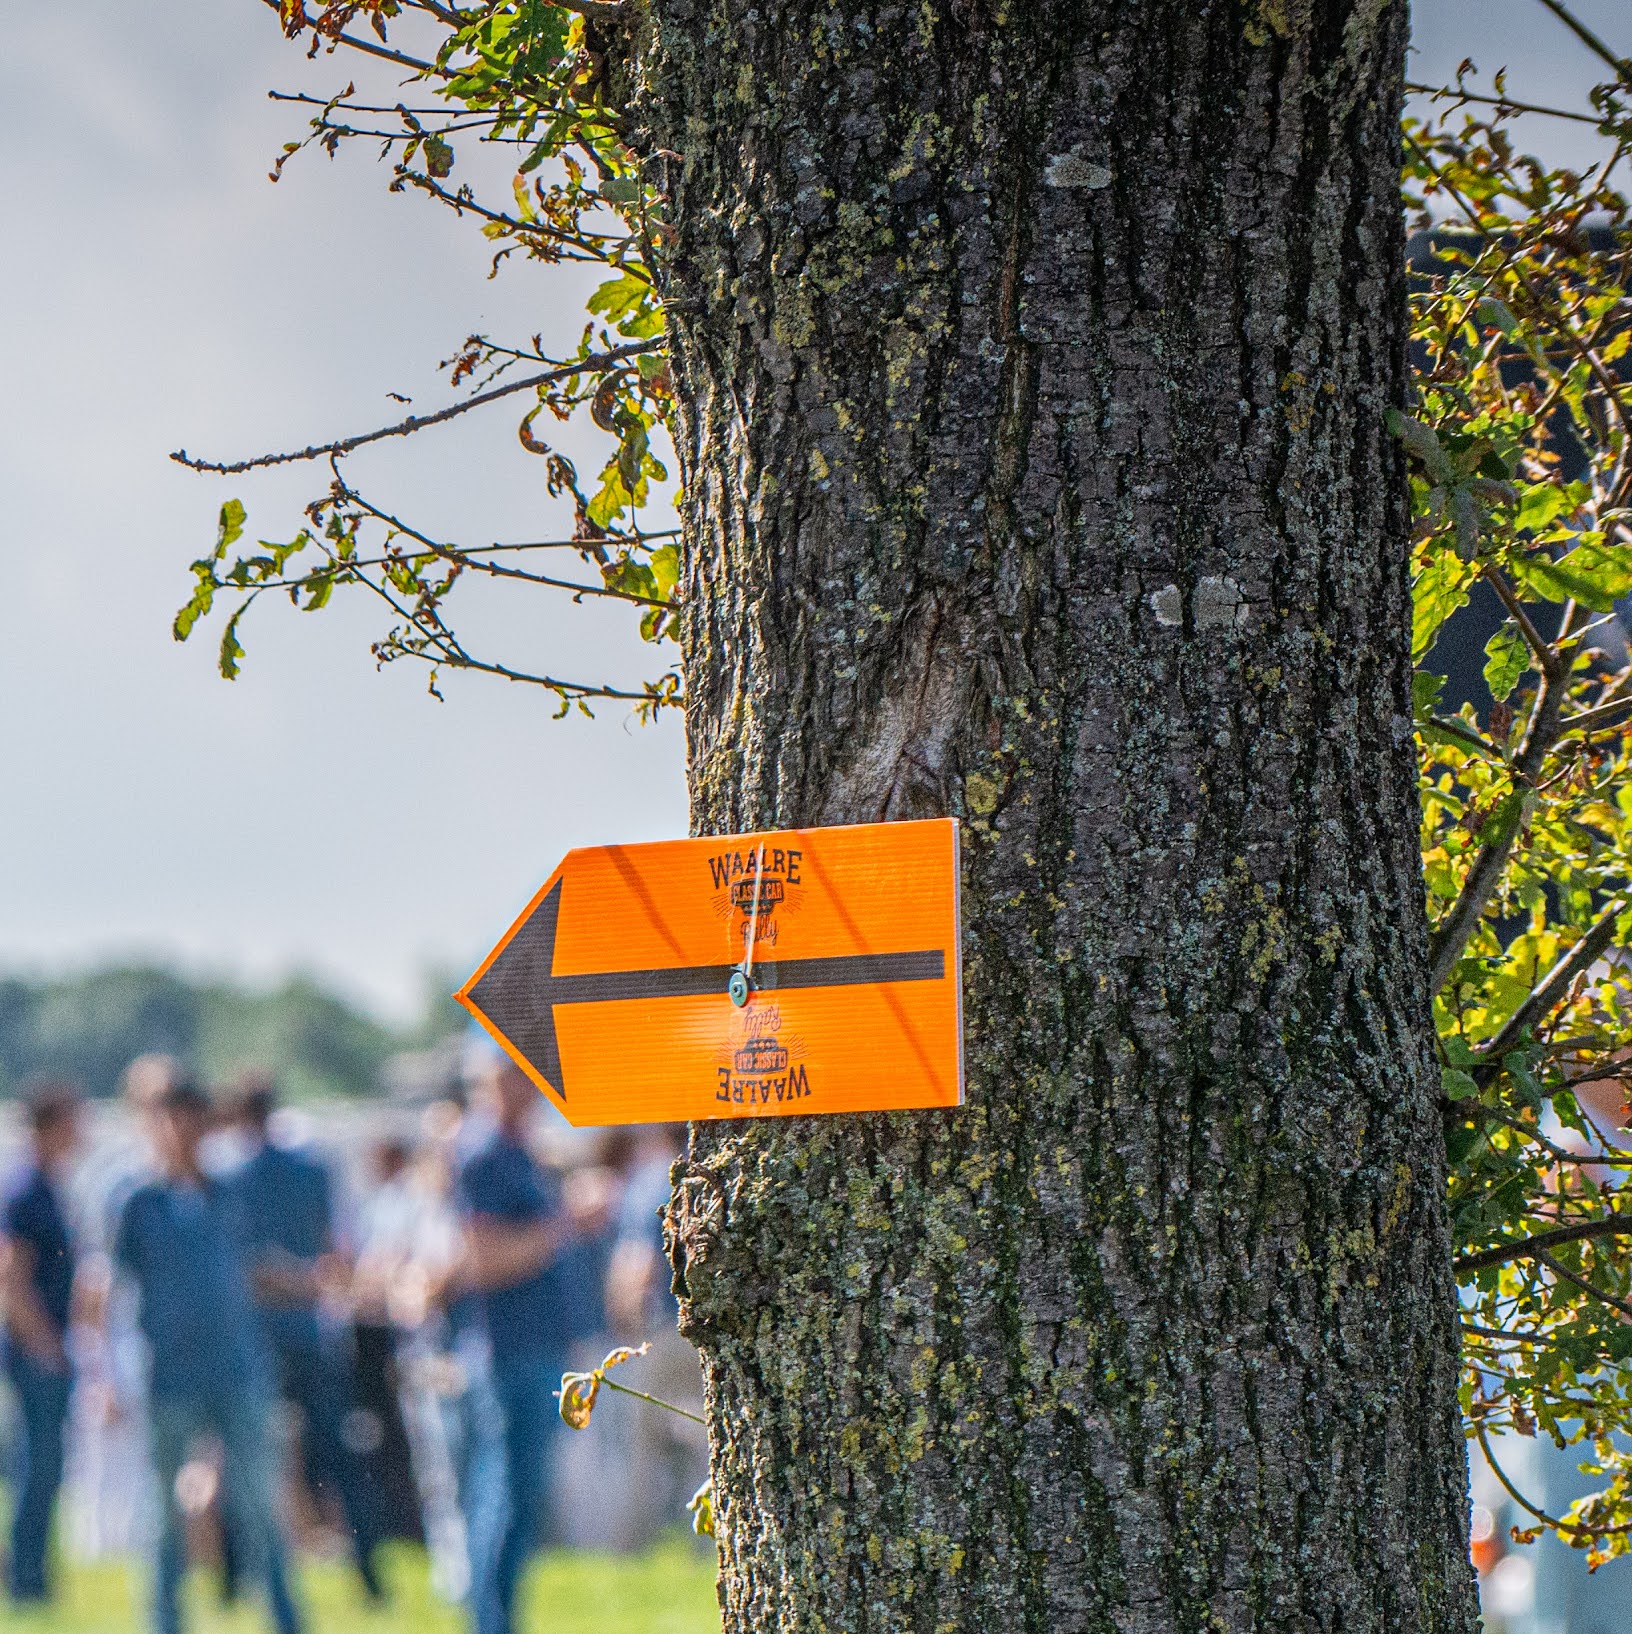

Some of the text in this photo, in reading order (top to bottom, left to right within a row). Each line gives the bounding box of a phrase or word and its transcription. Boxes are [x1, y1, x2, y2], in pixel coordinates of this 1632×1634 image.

[708, 848, 803, 890] WAALRE
[766, 882, 783, 900] CAR
[744, 1005, 782, 1038] Rally
[737, 1051, 787, 1070] CLASSIC CAR
[715, 1064, 812, 1104] WAALRE
